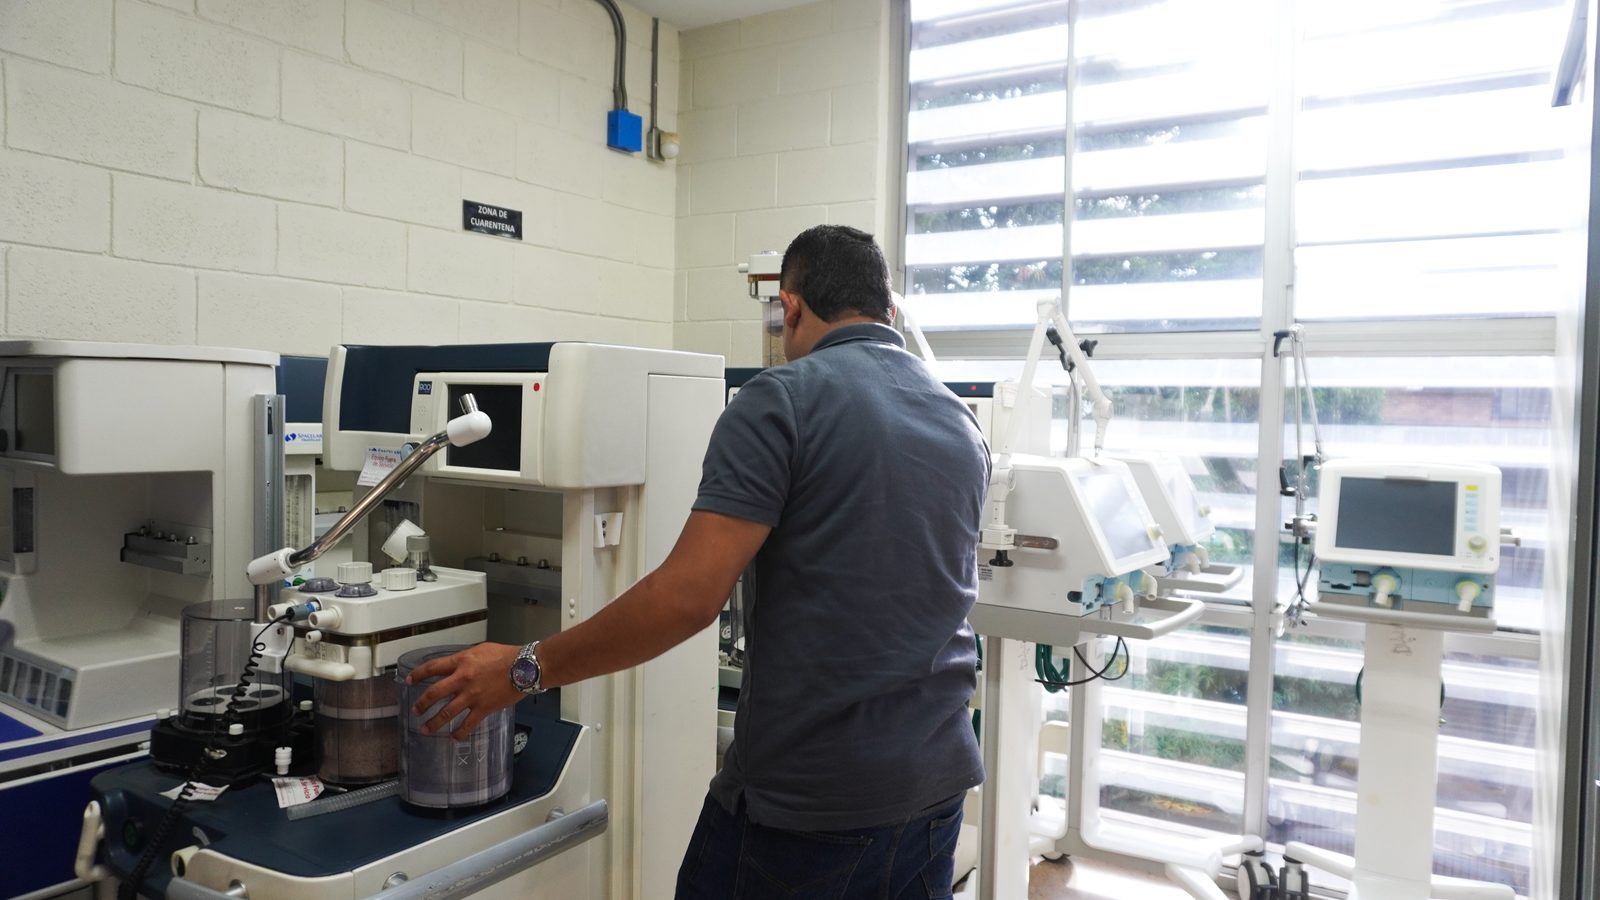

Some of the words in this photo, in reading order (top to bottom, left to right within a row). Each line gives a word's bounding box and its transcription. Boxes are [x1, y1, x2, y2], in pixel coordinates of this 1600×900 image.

[478, 205, 497, 217] ZONA
[499, 209, 508, 218] DE
[470, 217, 516, 233] CUARENTENA
